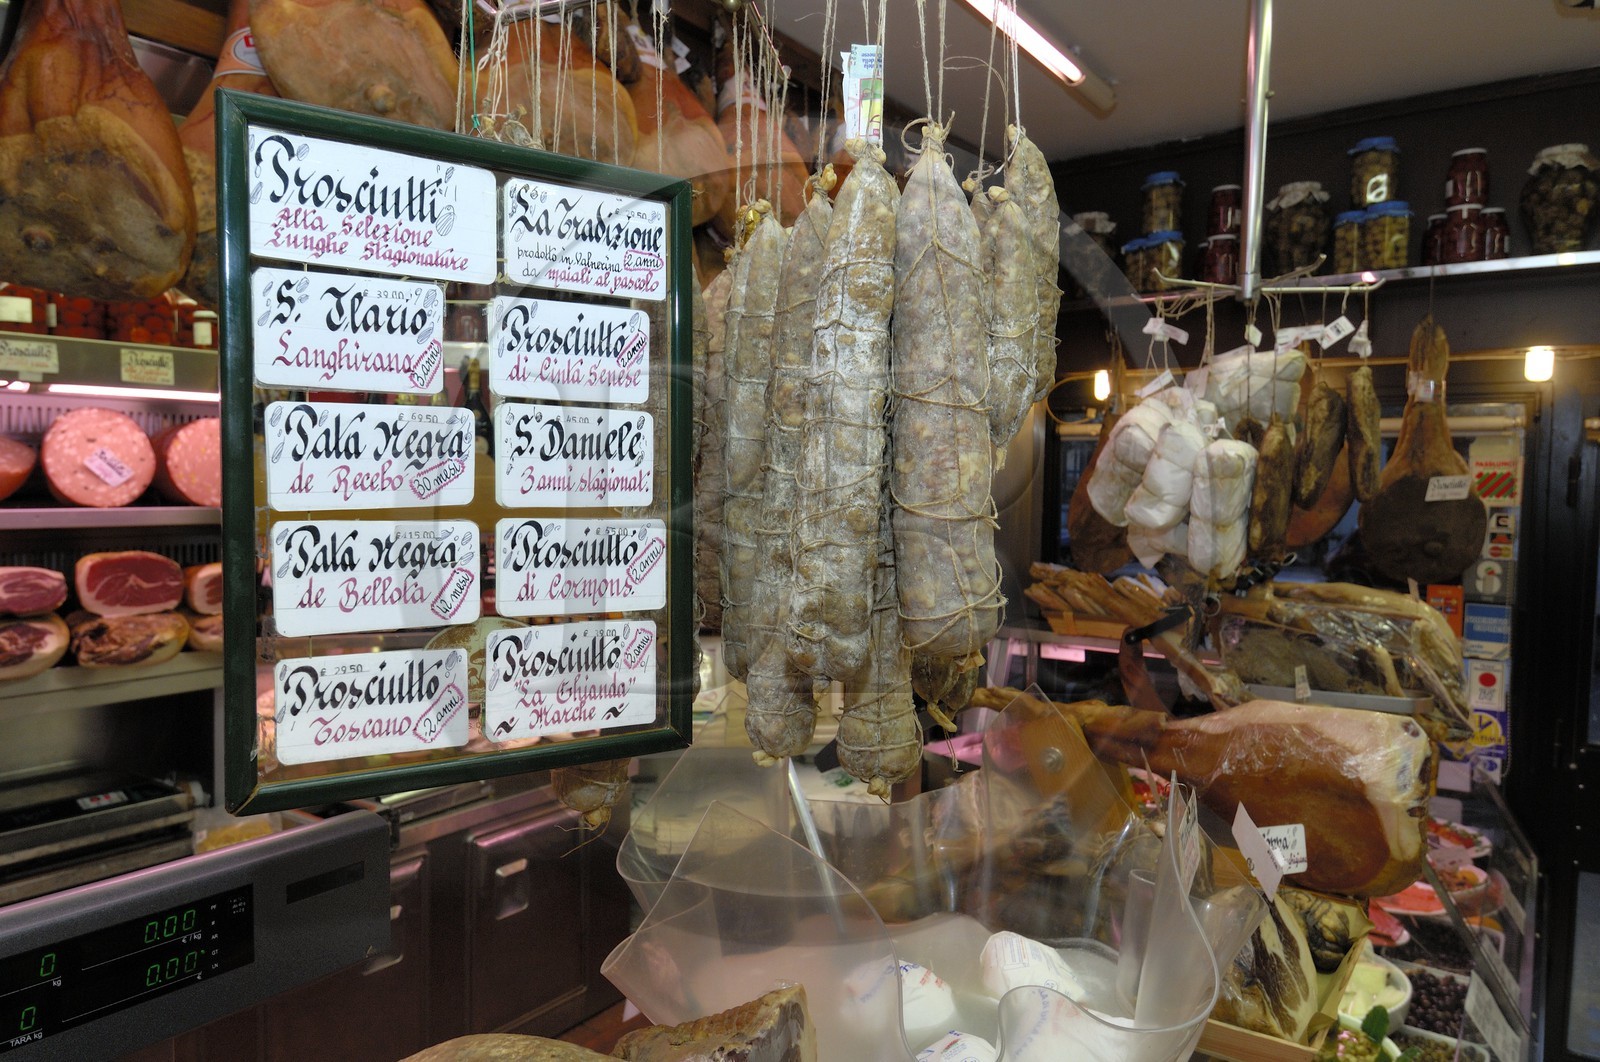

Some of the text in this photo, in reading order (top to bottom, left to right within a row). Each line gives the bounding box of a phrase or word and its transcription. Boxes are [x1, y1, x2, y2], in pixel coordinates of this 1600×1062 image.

[255, 135, 443, 224] Prosciutti
[271, 207, 433, 248] Alta Selezione
[510, 184, 663, 252] La Tradizione
[264, 227, 469, 271] Lunghe Stagionature
[518, 242, 661, 273] prodotto in Valnerina 2 anni
[523, 262, 660, 294] da maiali al pascolo
[269, 279, 427, 335] S. Ilario
[502, 304, 632, 358] Prosciutto
[620, 335, 646, 368] 2 anni
[272, 329, 415, 382] Langhirano
[413, 342, 442, 387] 3 anni
[506, 354, 642, 388] di Cinta Senese
[285, 404, 468, 471] Pata Negra
[510, 414, 642, 461] S. Daniele
[287, 459, 408, 501] de Recebo
[414, 462, 461, 496] 30 mesi
[520, 466, 535, 494] 3
[535, 465, 575, 492] anni
[285, 525, 460, 584] Pata Negra
[511, 520, 639, 572] Prosciutto
[631, 540, 661, 581] 2 anni
[297, 575, 432, 613] de Bellota
[437, 571, 470, 614] 42 mesi
[515, 571, 539, 602] di
[493, 633, 621, 682] Prosciutto
[625, 632, 650, 667] 2 anni
[284, 659, 443, 716] Prosciutto
[309, 711, 412, 746] Toscano
[424, 690, 461, 737] 2 anni
[529, 702, 596, 729] Marche
[144, 909, 196, 944] 0.00
[40, 953, 56, 977] 0
[53, 978, 62, 987] kg
[146, 951, 198, 987] 0.00
[20, 1006, 36, 1031] 0
[10, 1031, 43, 1048] TARA kg
